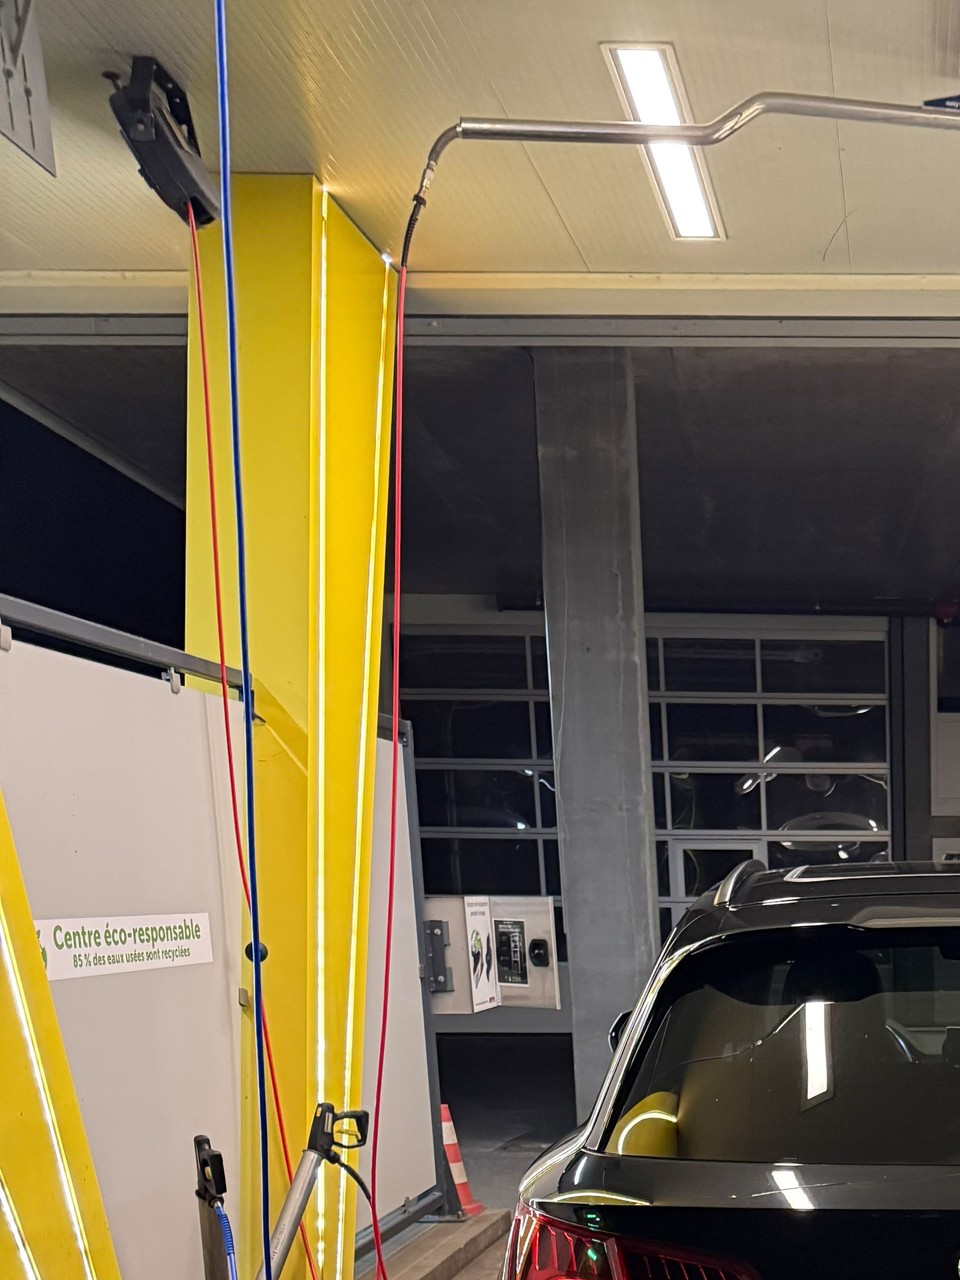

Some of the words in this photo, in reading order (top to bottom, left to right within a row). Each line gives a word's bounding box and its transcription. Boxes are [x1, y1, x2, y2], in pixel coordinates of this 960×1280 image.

[53, 925, 101, 950] Centre
[104, 919, 201, 948] éco-responsable
[73, 954, 83, 968] 85
[84, 953, 92, 967] %
[93, 953, 106, 966] des
[107, 954, 124, 965] eaux
[125, 949, 145, 963] usées
[146, 948, 160, 961] sont
[161, 945, 191, 962] recyclées
